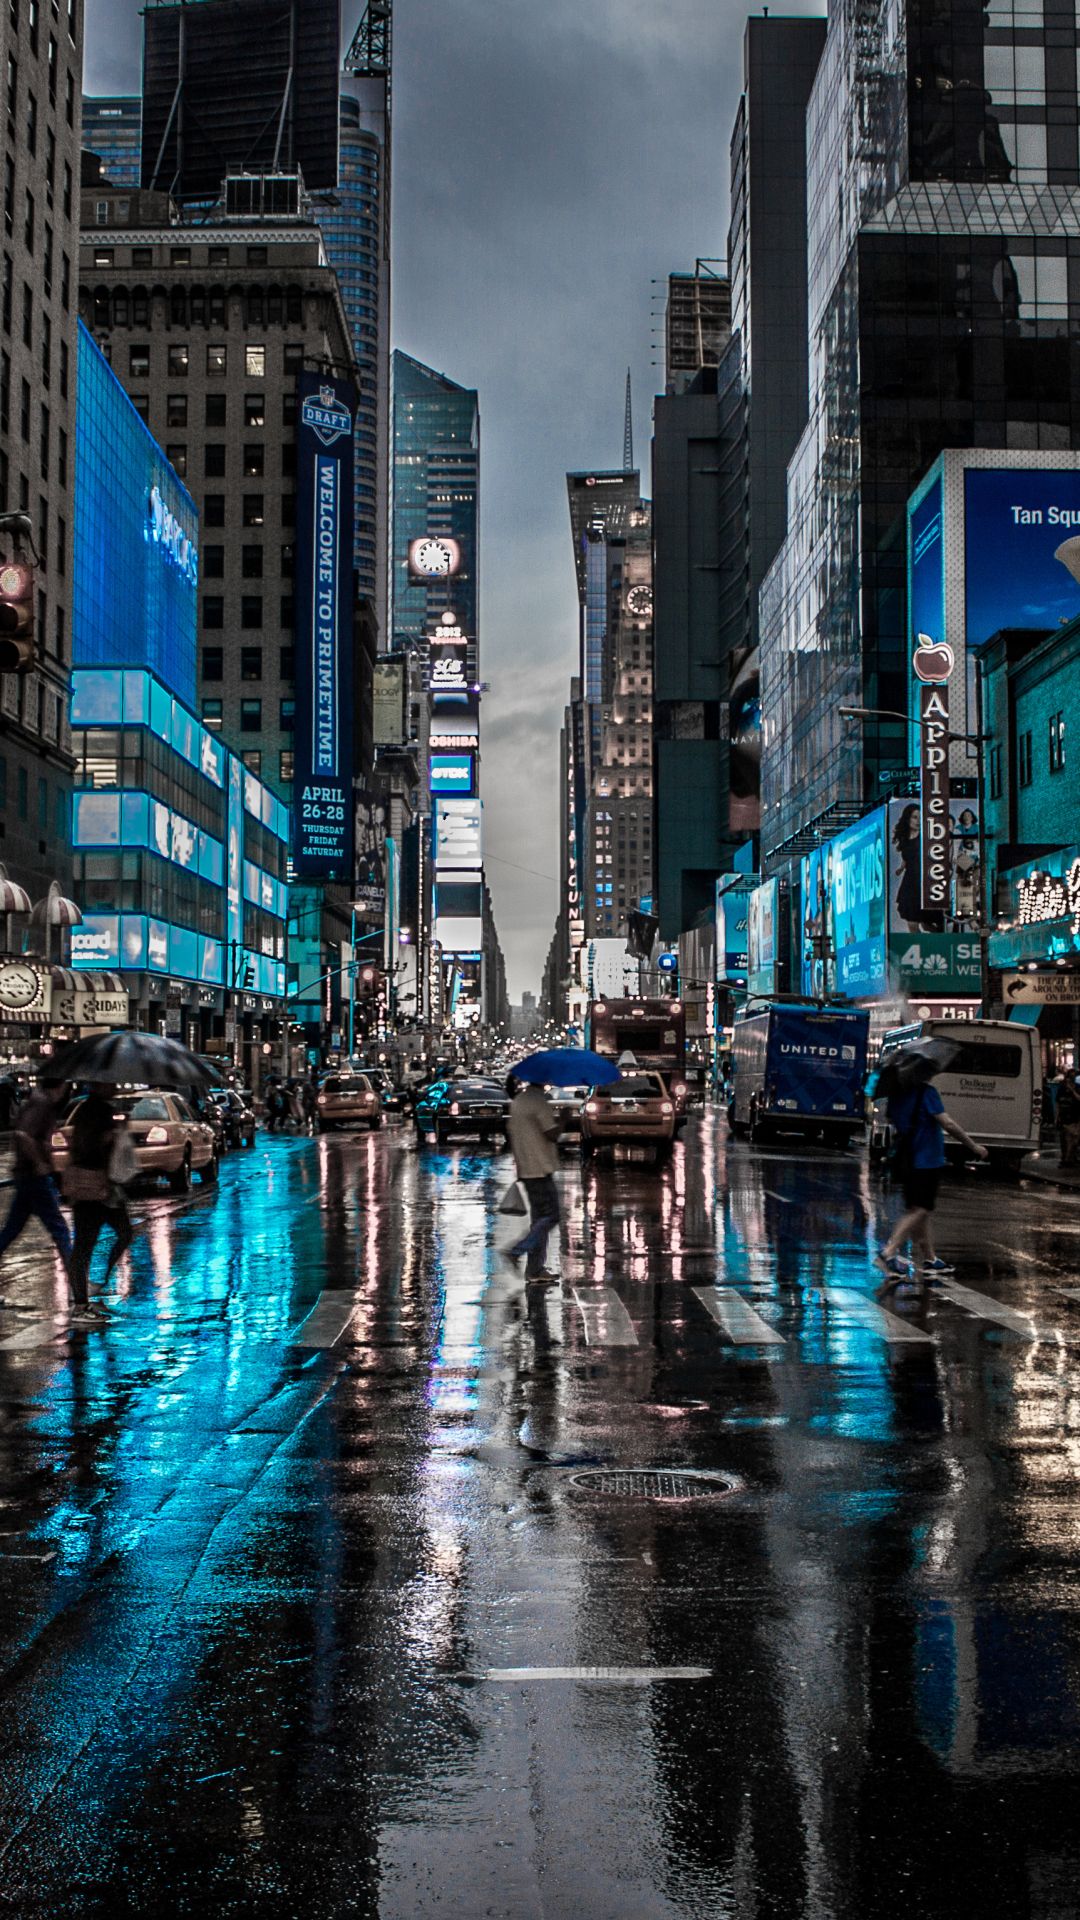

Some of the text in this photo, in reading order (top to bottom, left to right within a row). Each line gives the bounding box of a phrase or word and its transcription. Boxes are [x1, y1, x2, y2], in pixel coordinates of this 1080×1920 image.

[306, 408, 347, 428] DRAFT
[1011, 506, 1080, 528] Tan Squ
[319, 465, 334, 767] WELCOME TO PRIMETIME
[302, 786, 345, 802] APRIL
[302, 804, 345, 820] 26-28
[302, 824, 345, 835] THURSDAY
[309, 836, 338, 846] FRIDAY
[302, 847, 344, 857] SATURDAY
[901, 944, 923, 970] 4
[957, 965, 982, 976] WE
[780, 1044, 838, 1056] UNITED
